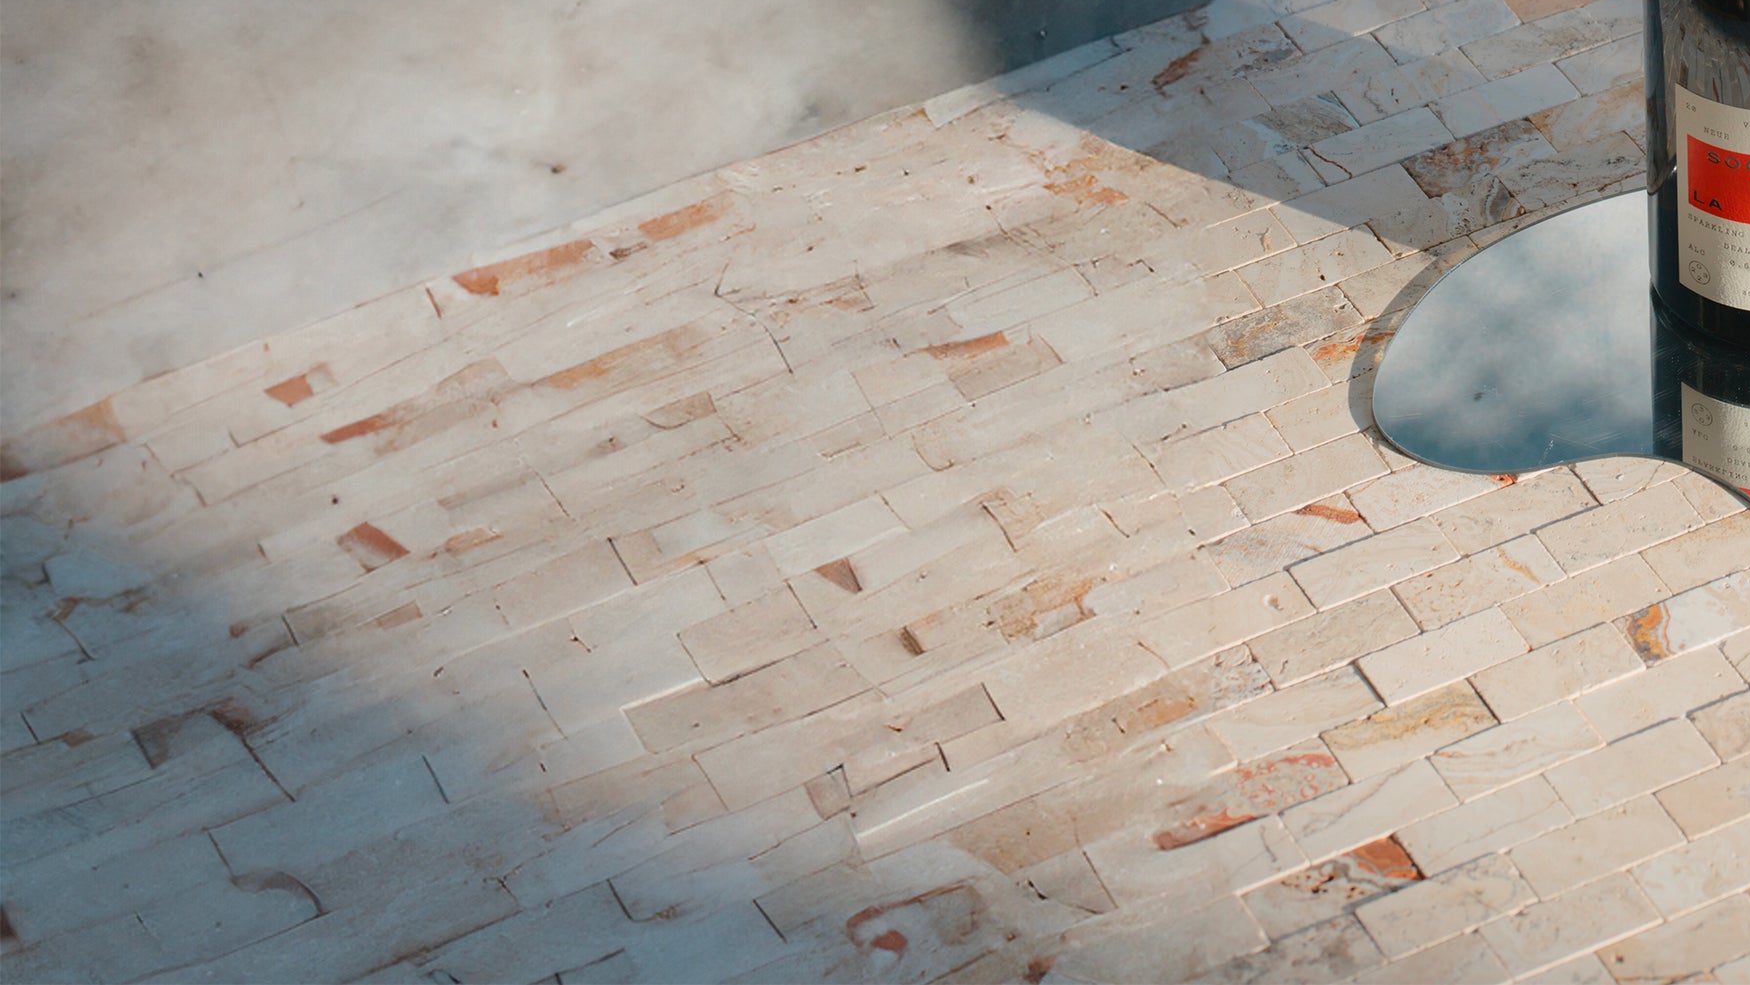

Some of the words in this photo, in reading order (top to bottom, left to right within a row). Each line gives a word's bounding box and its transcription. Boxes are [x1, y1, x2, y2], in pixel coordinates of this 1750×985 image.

[1703, 126, 1730, 140] NEUE
[1693, 189, 1722, 211] LA
[1687, 213, 1745, 238] SPARKLING
[1688, 243, 1706, 256] ALC
